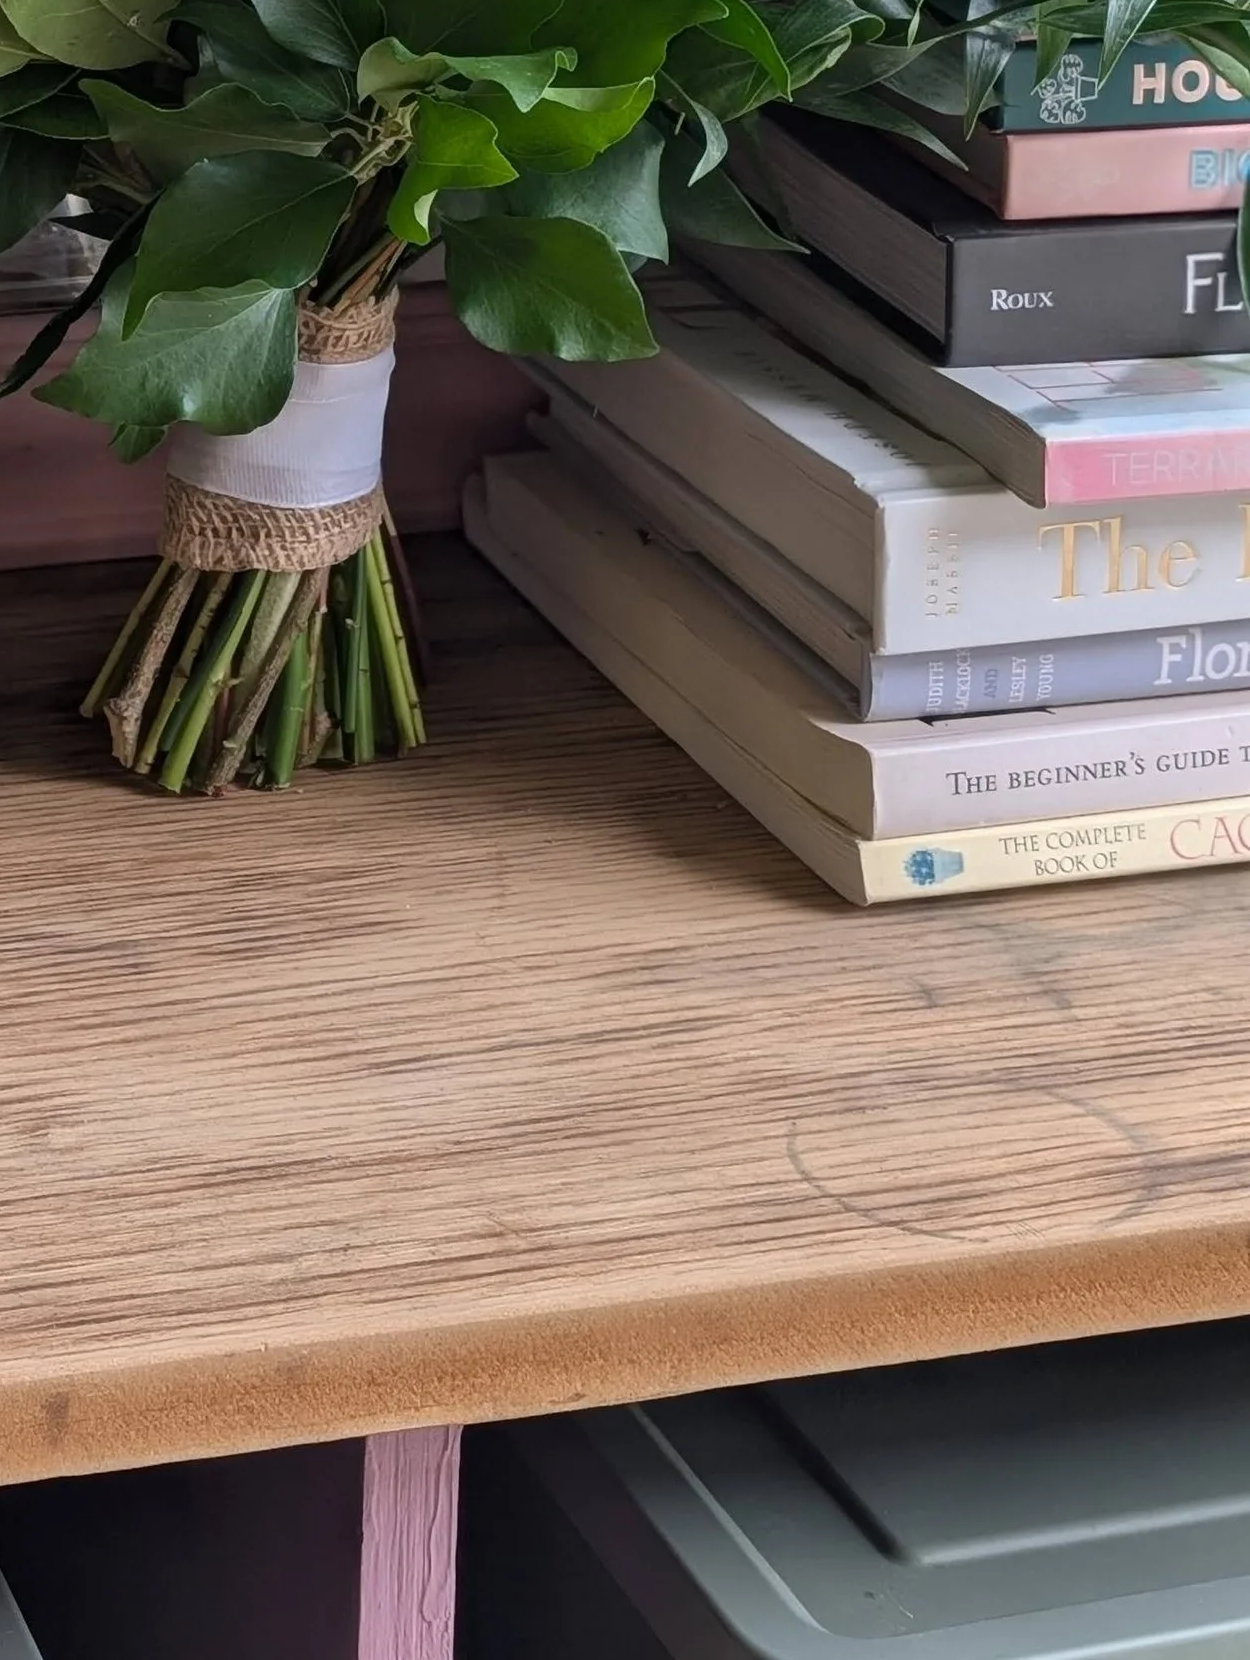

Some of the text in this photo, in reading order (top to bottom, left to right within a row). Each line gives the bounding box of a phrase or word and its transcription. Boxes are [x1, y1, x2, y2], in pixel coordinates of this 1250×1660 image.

[1038, 514, 1201, 603] The
[926, 660, 944, 713] JUDITH
[983, 667, 998, 699] AND
[1009, 656, 1026, 703] LESLEY
[1036, 653, 1054, 702] YOUNG
[1008, 751, 1146, 790] BEGINNER'S
[1156, 748, 1230, 773] GUIDE
[999, 823, 1146, 856] THE COMPLETE
[1034, 851, 1118, 877] BOOK OF
